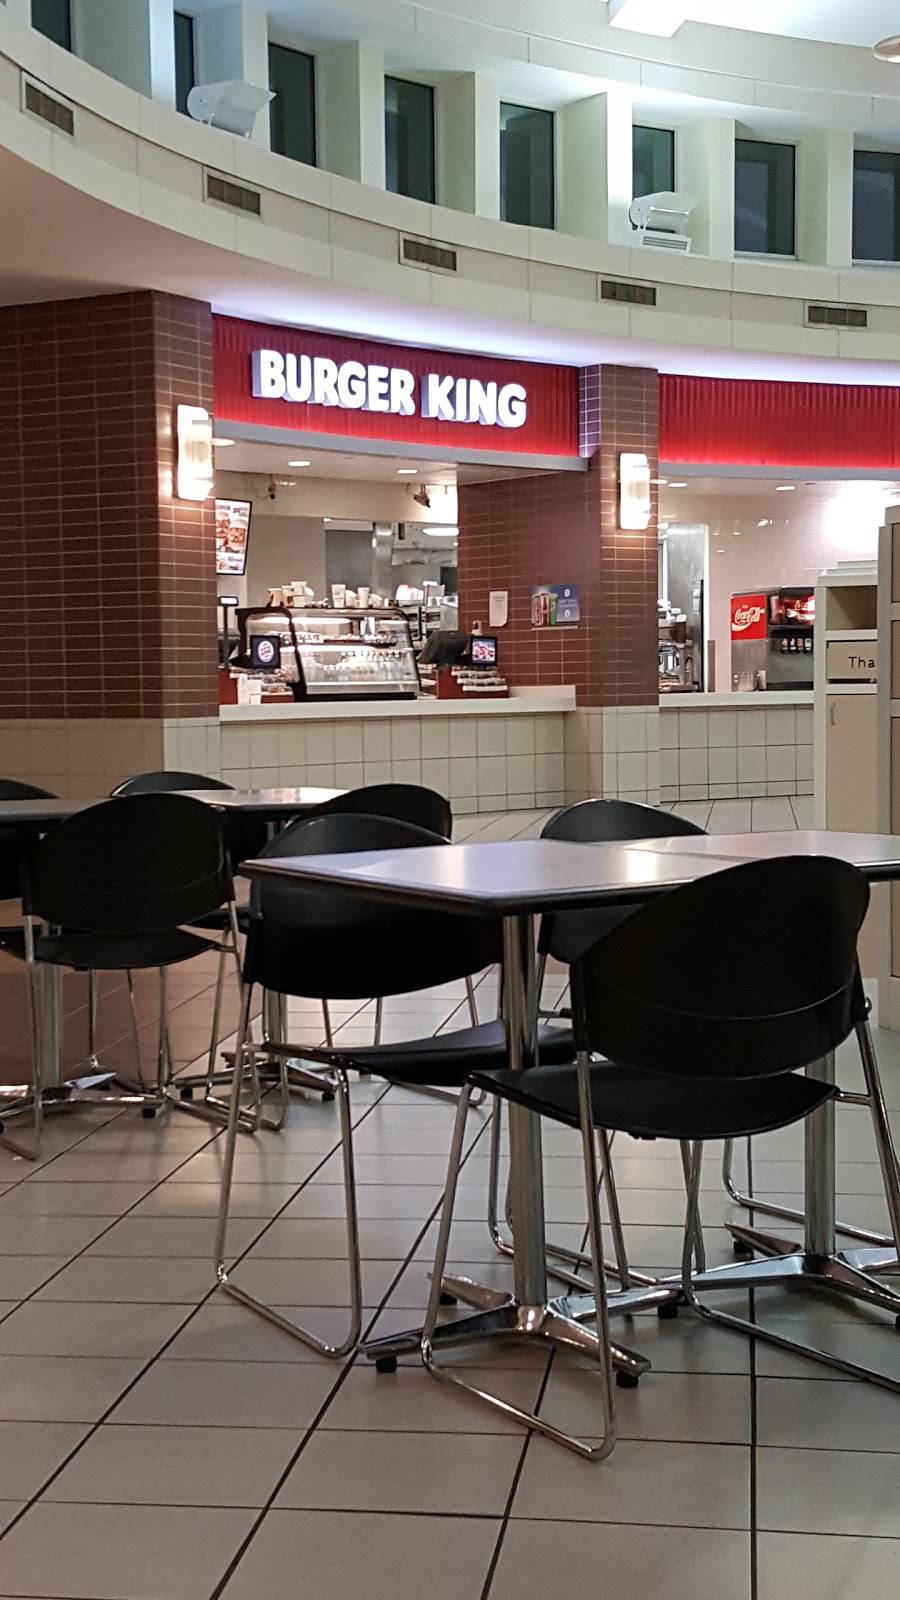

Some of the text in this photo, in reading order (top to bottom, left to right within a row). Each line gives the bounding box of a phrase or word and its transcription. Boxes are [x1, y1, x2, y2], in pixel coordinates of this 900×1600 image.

[253, 349, 527, 428] BURGER KING
[847, 656, 875, 669] Tha
